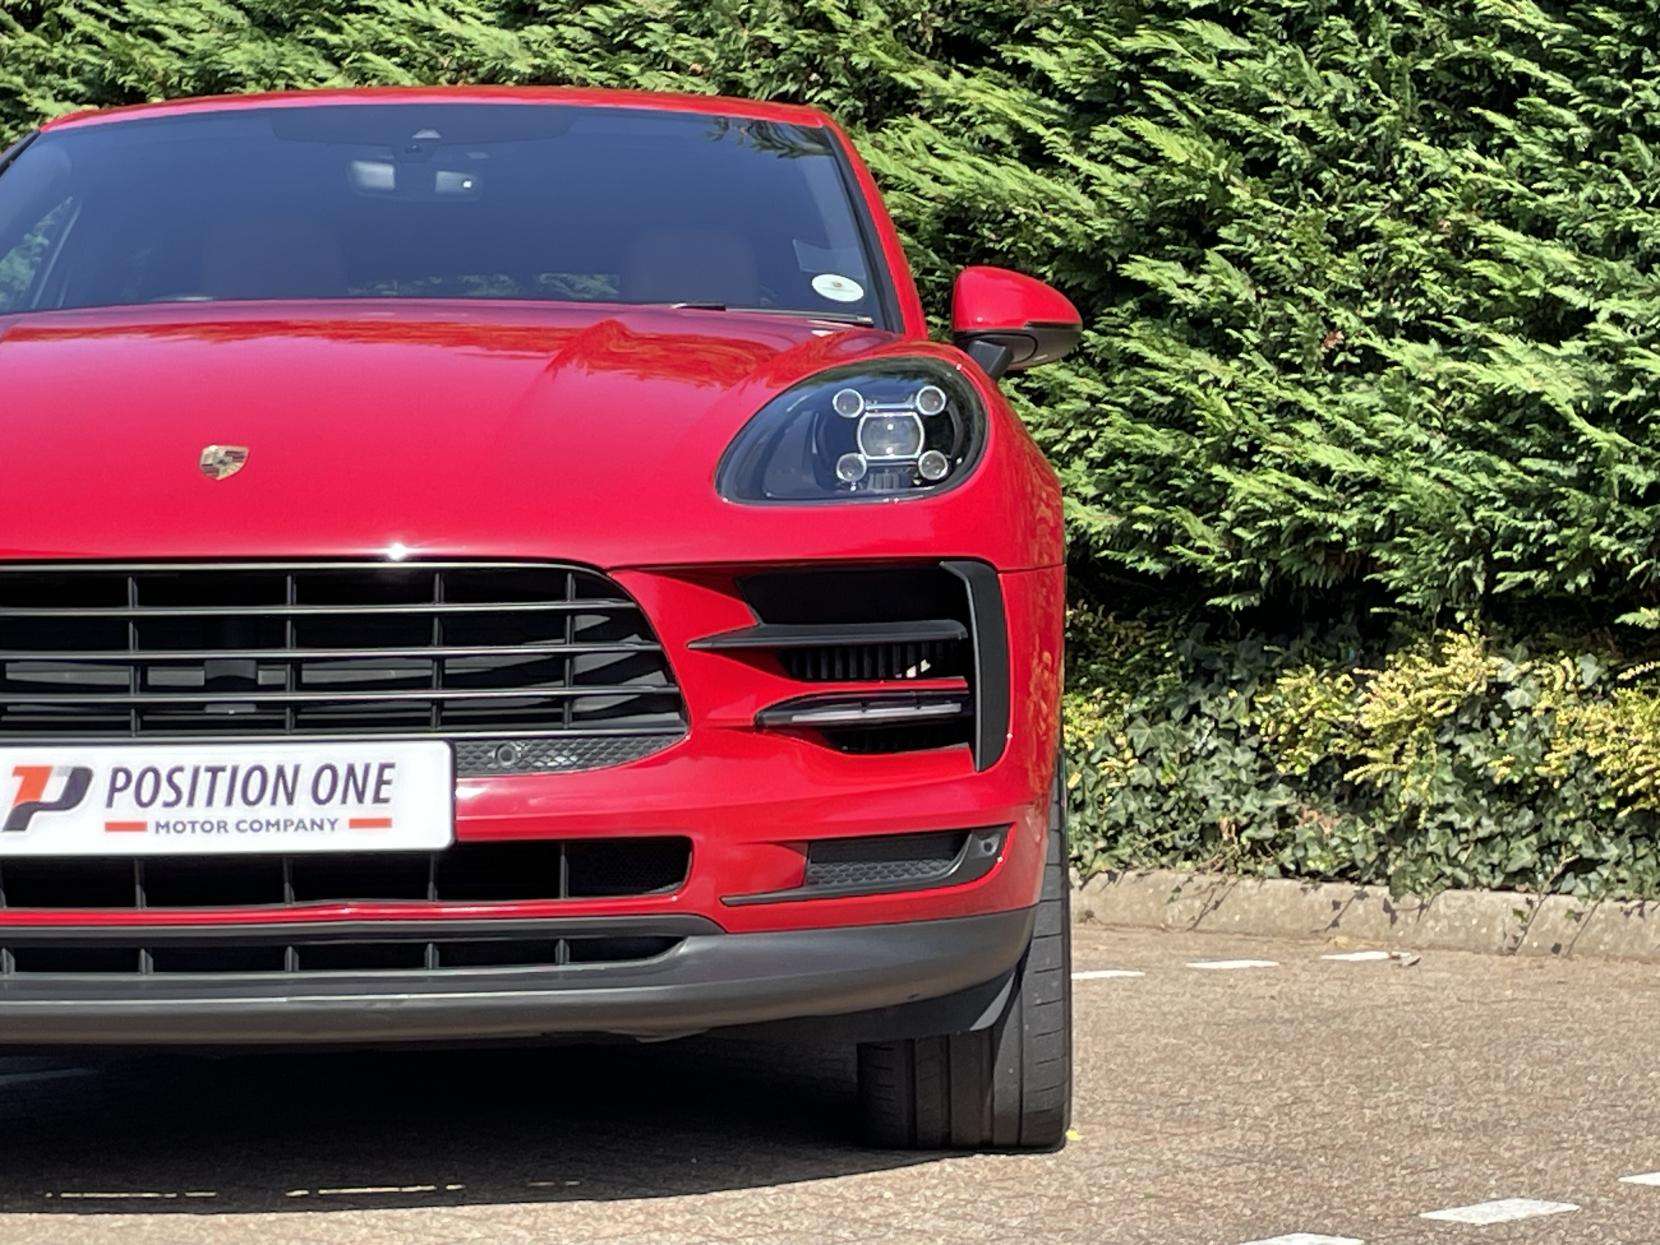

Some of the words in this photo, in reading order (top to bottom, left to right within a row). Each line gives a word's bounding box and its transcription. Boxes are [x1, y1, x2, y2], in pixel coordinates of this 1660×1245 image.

[105, 764, 301, 808] POSITION
[311, 762, 396, 804] ONE
[155, 818, 229, 835] MOTOR
[235, 818, 339, 834] COMPANY
